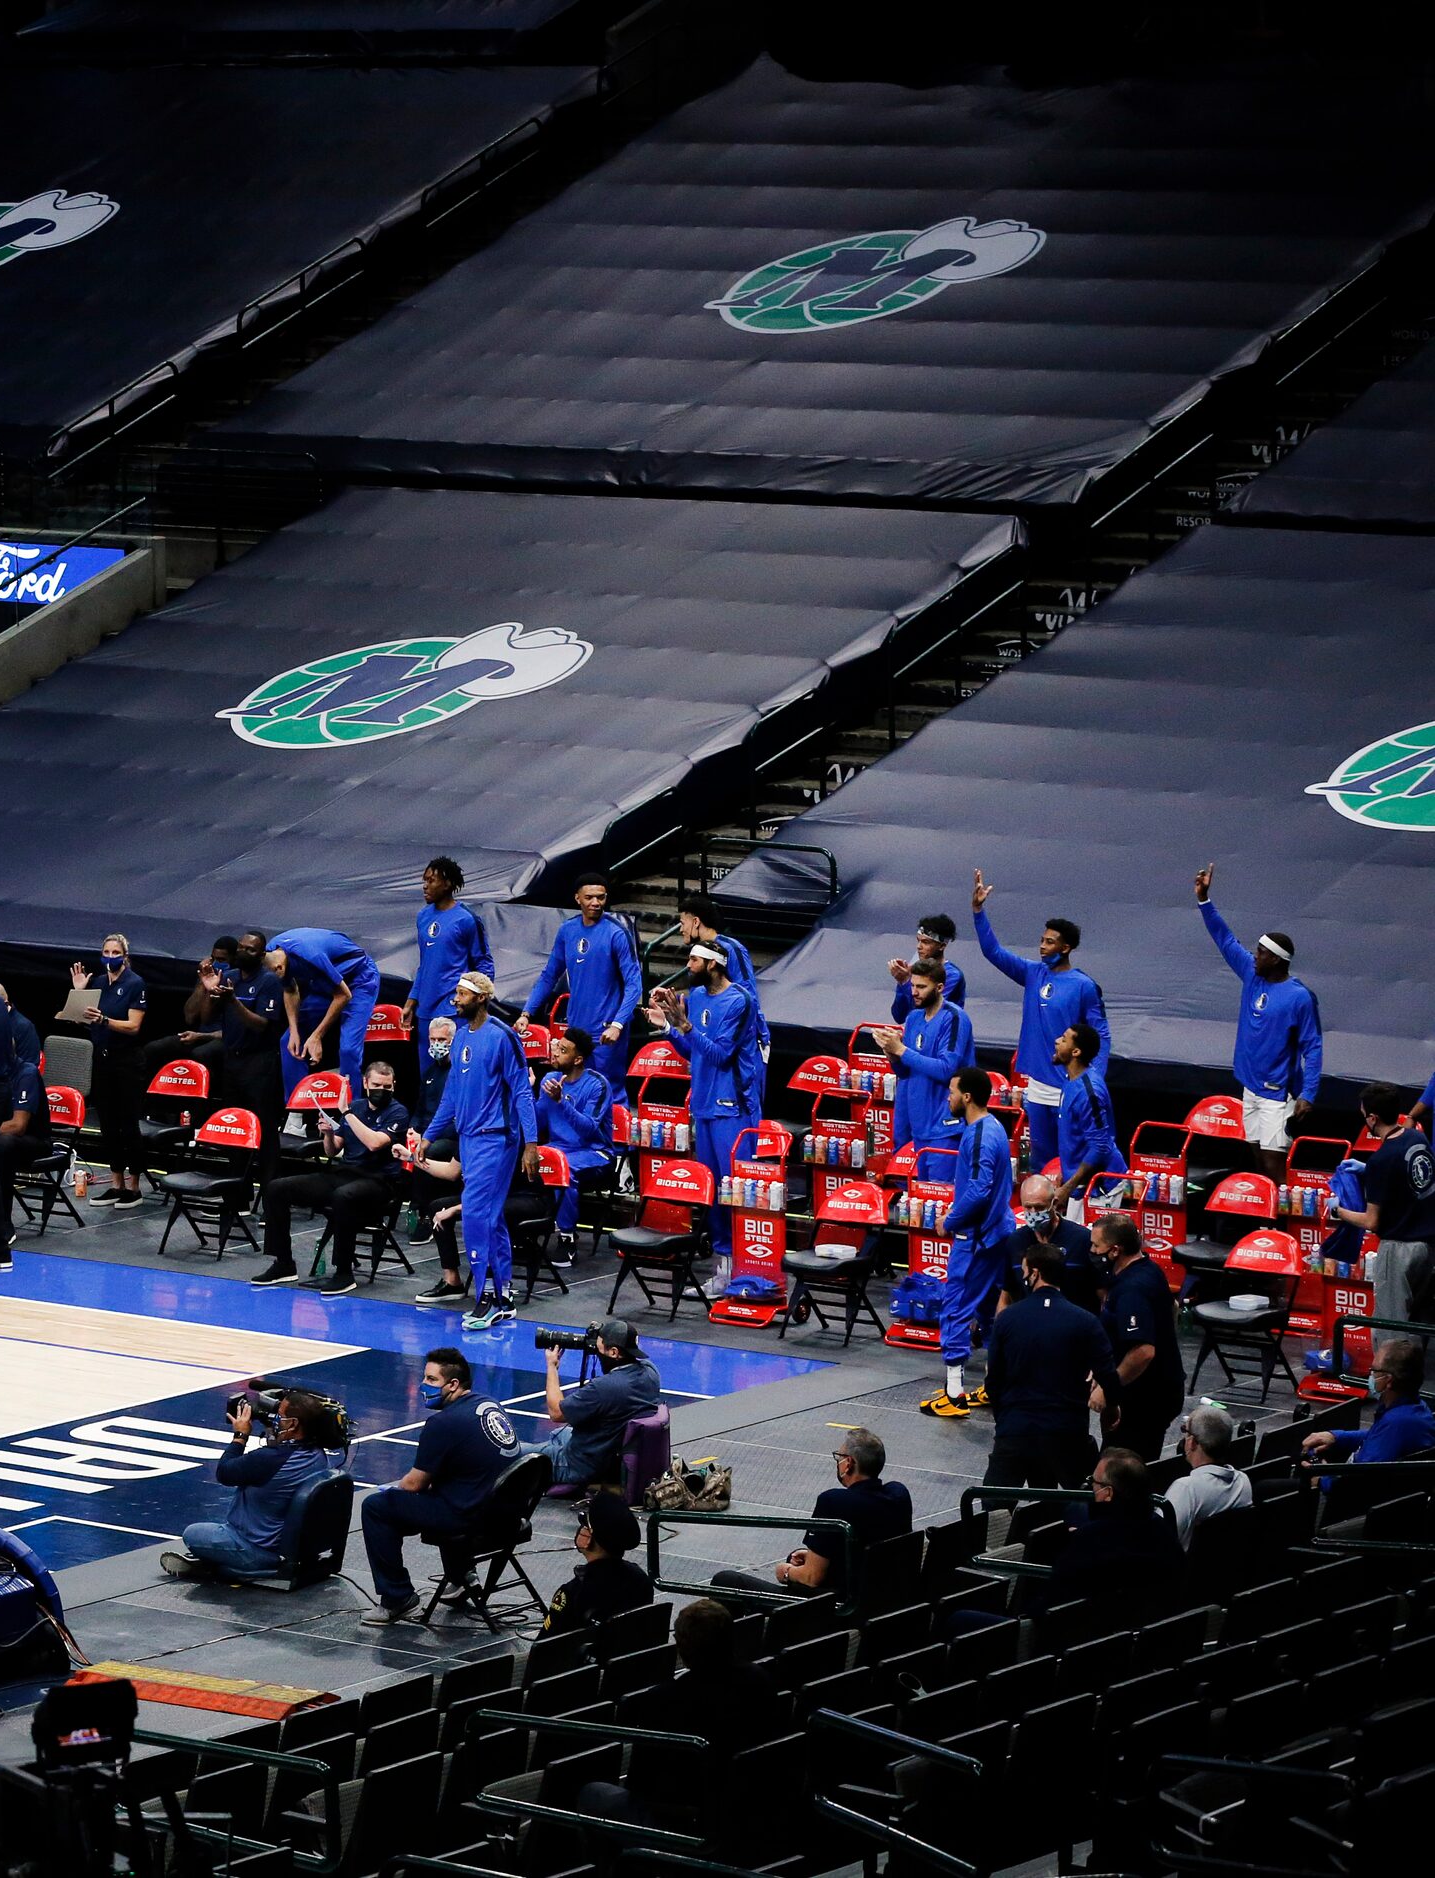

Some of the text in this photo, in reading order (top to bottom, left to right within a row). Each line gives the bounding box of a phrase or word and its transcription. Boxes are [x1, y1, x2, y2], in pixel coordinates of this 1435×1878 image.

[1175, 515, 1212, 527] RESOR
[638, 1058, 682, 1067] BIOSTEEL
[159, 1075, 197, 1085] BIOSTEEL
[797, 1071, 838, 1085] BIOSTEEL
[1193, 1113, 1238, 1127] BIOSTEEL
[206, 1123, 246, 1136] BIOSTEEL
[656, 1178, 700, 1190] BIOSTEEL
[1219, 1191, 1264, 1204] BIOSTEEL
[827, 1200, 873, 1211] BIOSTEEL
[744, 1218, 774, 1236] BIO
[1144, 1212, 1173, 1229] BIO
[744, 1234, 773, 1244] STEEL
[1144, 1228, 1173, 1237] STEEL
[921, 1240, 950, 1256] BIO
[1236, 1248, 1286, 1261] BIOSTEEL
[1335, 1289, 1367, 1308] BIO
[1335, 1305, 1367, 1316] STEEL
